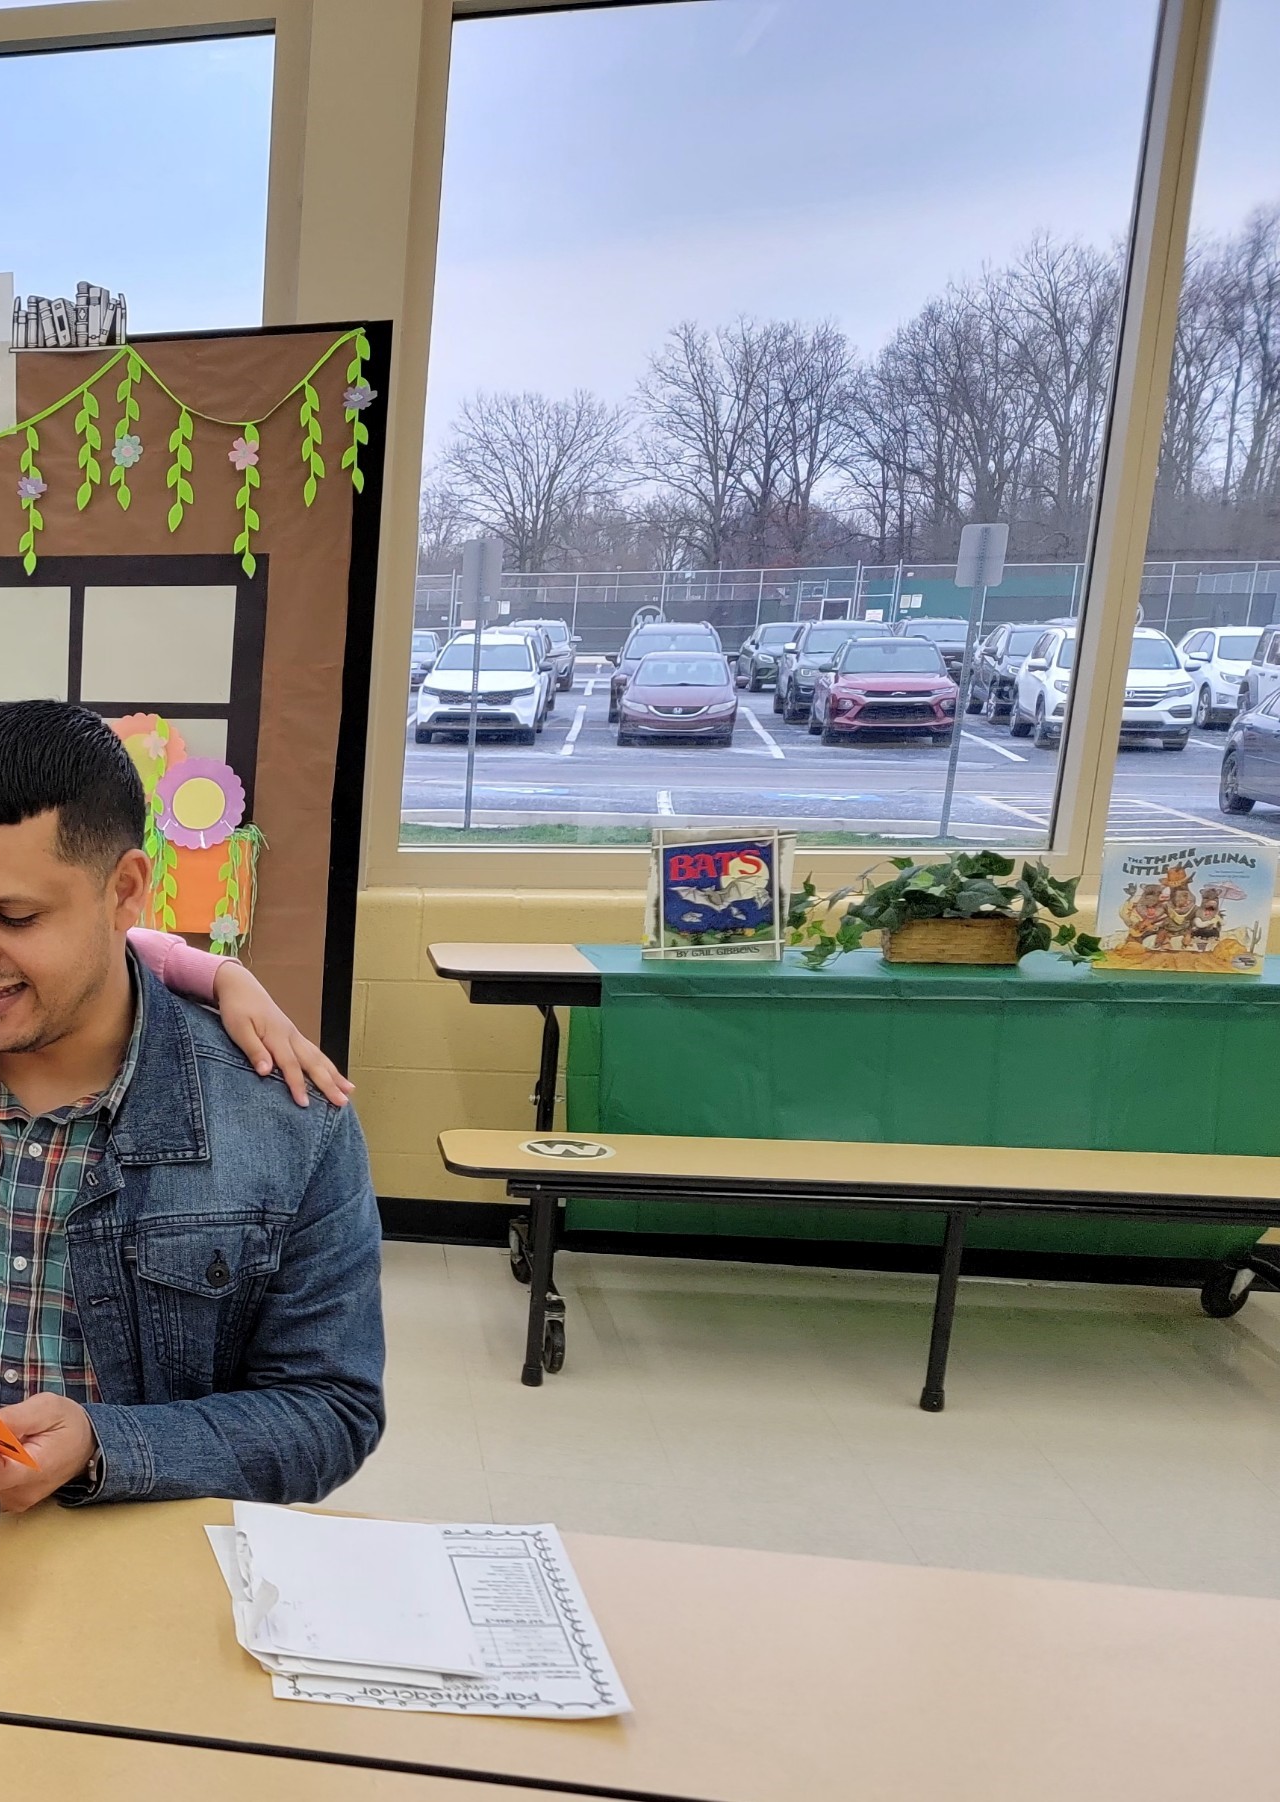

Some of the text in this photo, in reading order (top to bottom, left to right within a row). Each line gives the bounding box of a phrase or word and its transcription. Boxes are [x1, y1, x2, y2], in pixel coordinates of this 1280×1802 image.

[1127, 848, 1196, 864] THE THREE
[670, 849, 762, 881] BATS
[1122, 862, 1170, 876] LITTLE
[676, 945, 760, 958] BY GAIL GIBBONS
